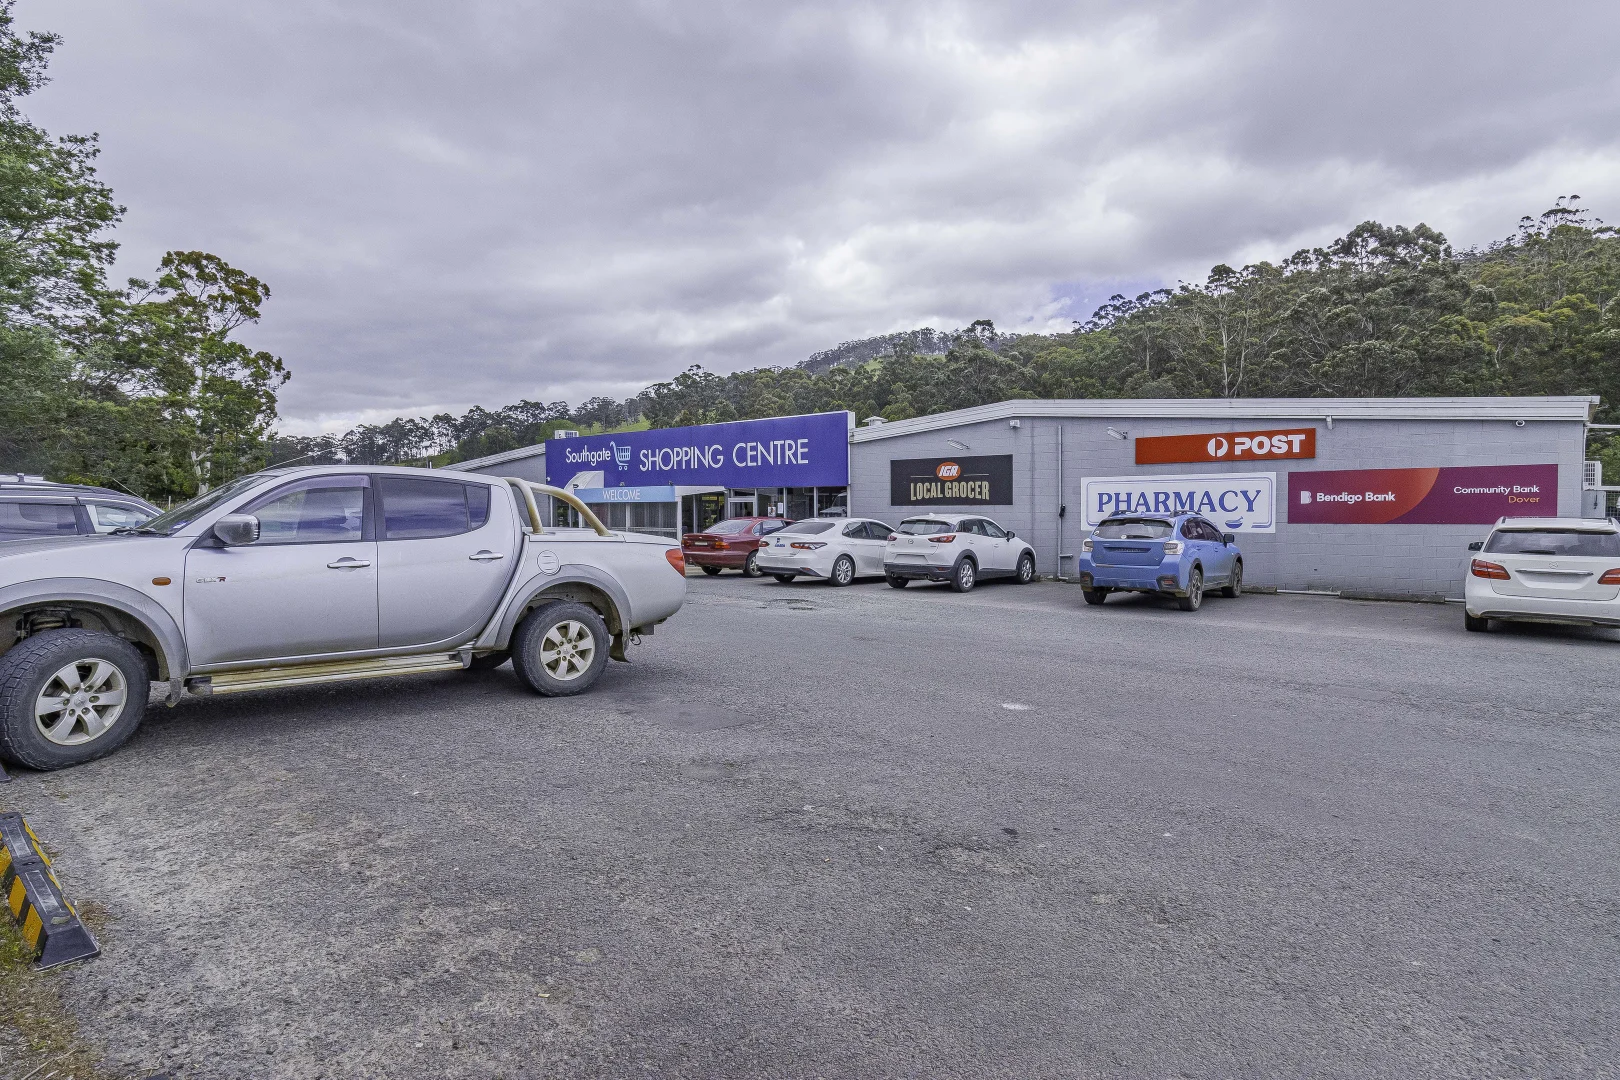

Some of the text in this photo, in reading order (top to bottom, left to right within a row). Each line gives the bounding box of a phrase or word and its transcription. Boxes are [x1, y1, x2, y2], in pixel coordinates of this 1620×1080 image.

[1234, 434, 1306, 455] POST
[565, 445, 611, 467] Southgate
[639, 438, 809, 472] SHOPPING CENTRE
[938, 465, 959, 477] IGA
[603, 489, 641, 501] WELCOME
[910, 481, 990, 501] LOCAL GROCER
[1316, 491, 1363, 505] Bendigo
[1365, 491, 1396, 502] Bank
[1453, 484, 1540, 496] Community Bank
[1097, 489, 1262, 513] PHARMACY
[1508, 495, 1540, 504] Dover
